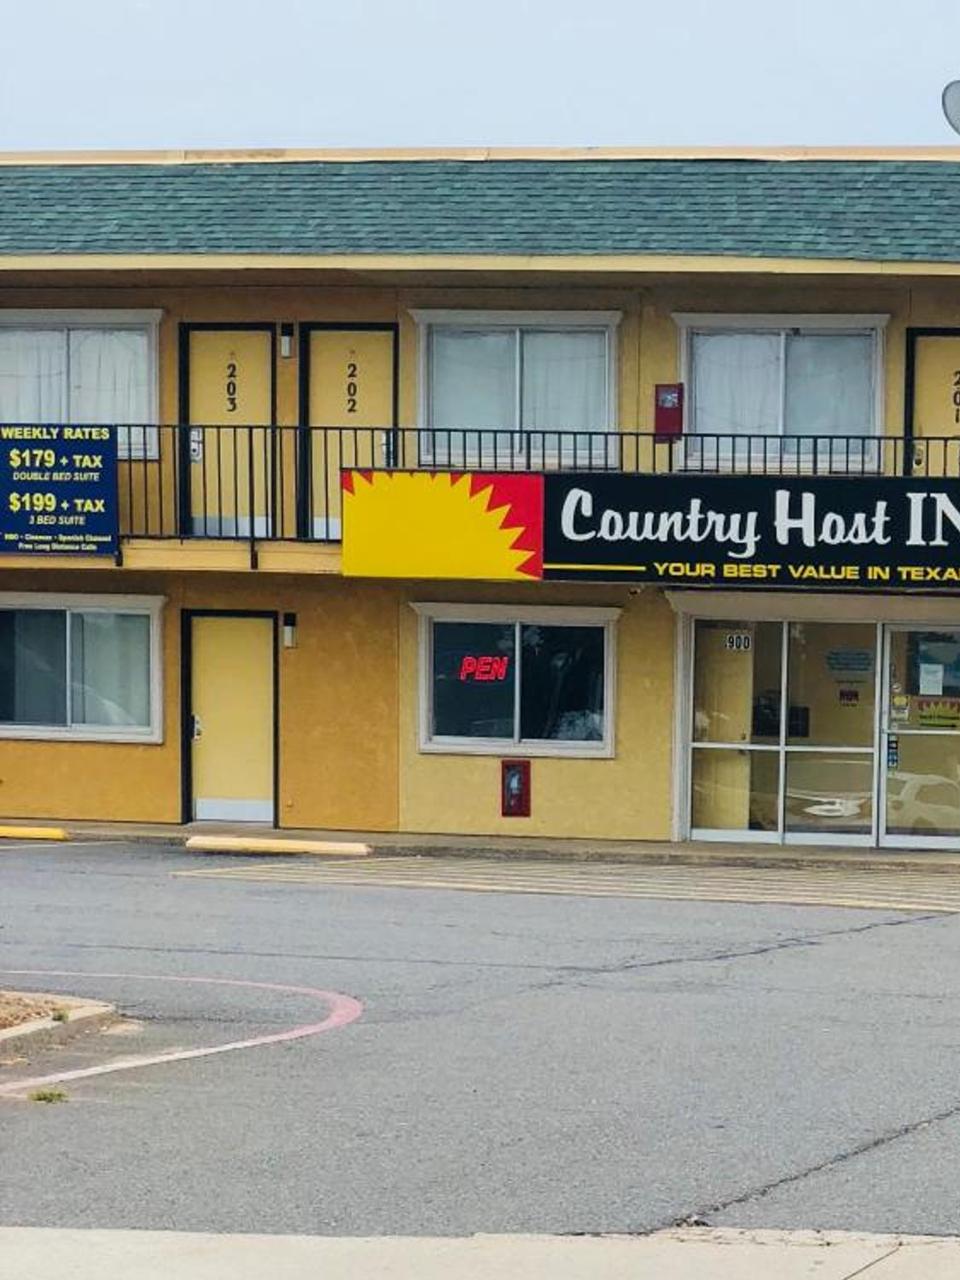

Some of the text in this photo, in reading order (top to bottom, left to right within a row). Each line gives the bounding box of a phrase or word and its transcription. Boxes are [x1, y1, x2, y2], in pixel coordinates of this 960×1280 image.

[226, 363, 237, 412] 203
[347, 363, 357, 412] 202
[1, 427, 110, 440] WEEKLY RATES
[9, 448, 56, 468] $179
[73, 455, 103, 468] TAX
[13, 472, 100, 482] DOUBLE BED SUITE
[9, 491, 57, 512] $199
[73, 499, 105, 512] TAX
[36, 515, 57, 525] BED
[58, 515, 86, 525] SUITE
[560, 487, 761, 558] Country
[774, 489, 892, 547] Host
[653, 562, 716, 578] YOUR
[722, 563, 781, 579] BEST
[788, 565, 860, 580] VALUE
[867, 566, 890, 580] IN
[728, 635, 751, 649] 900
